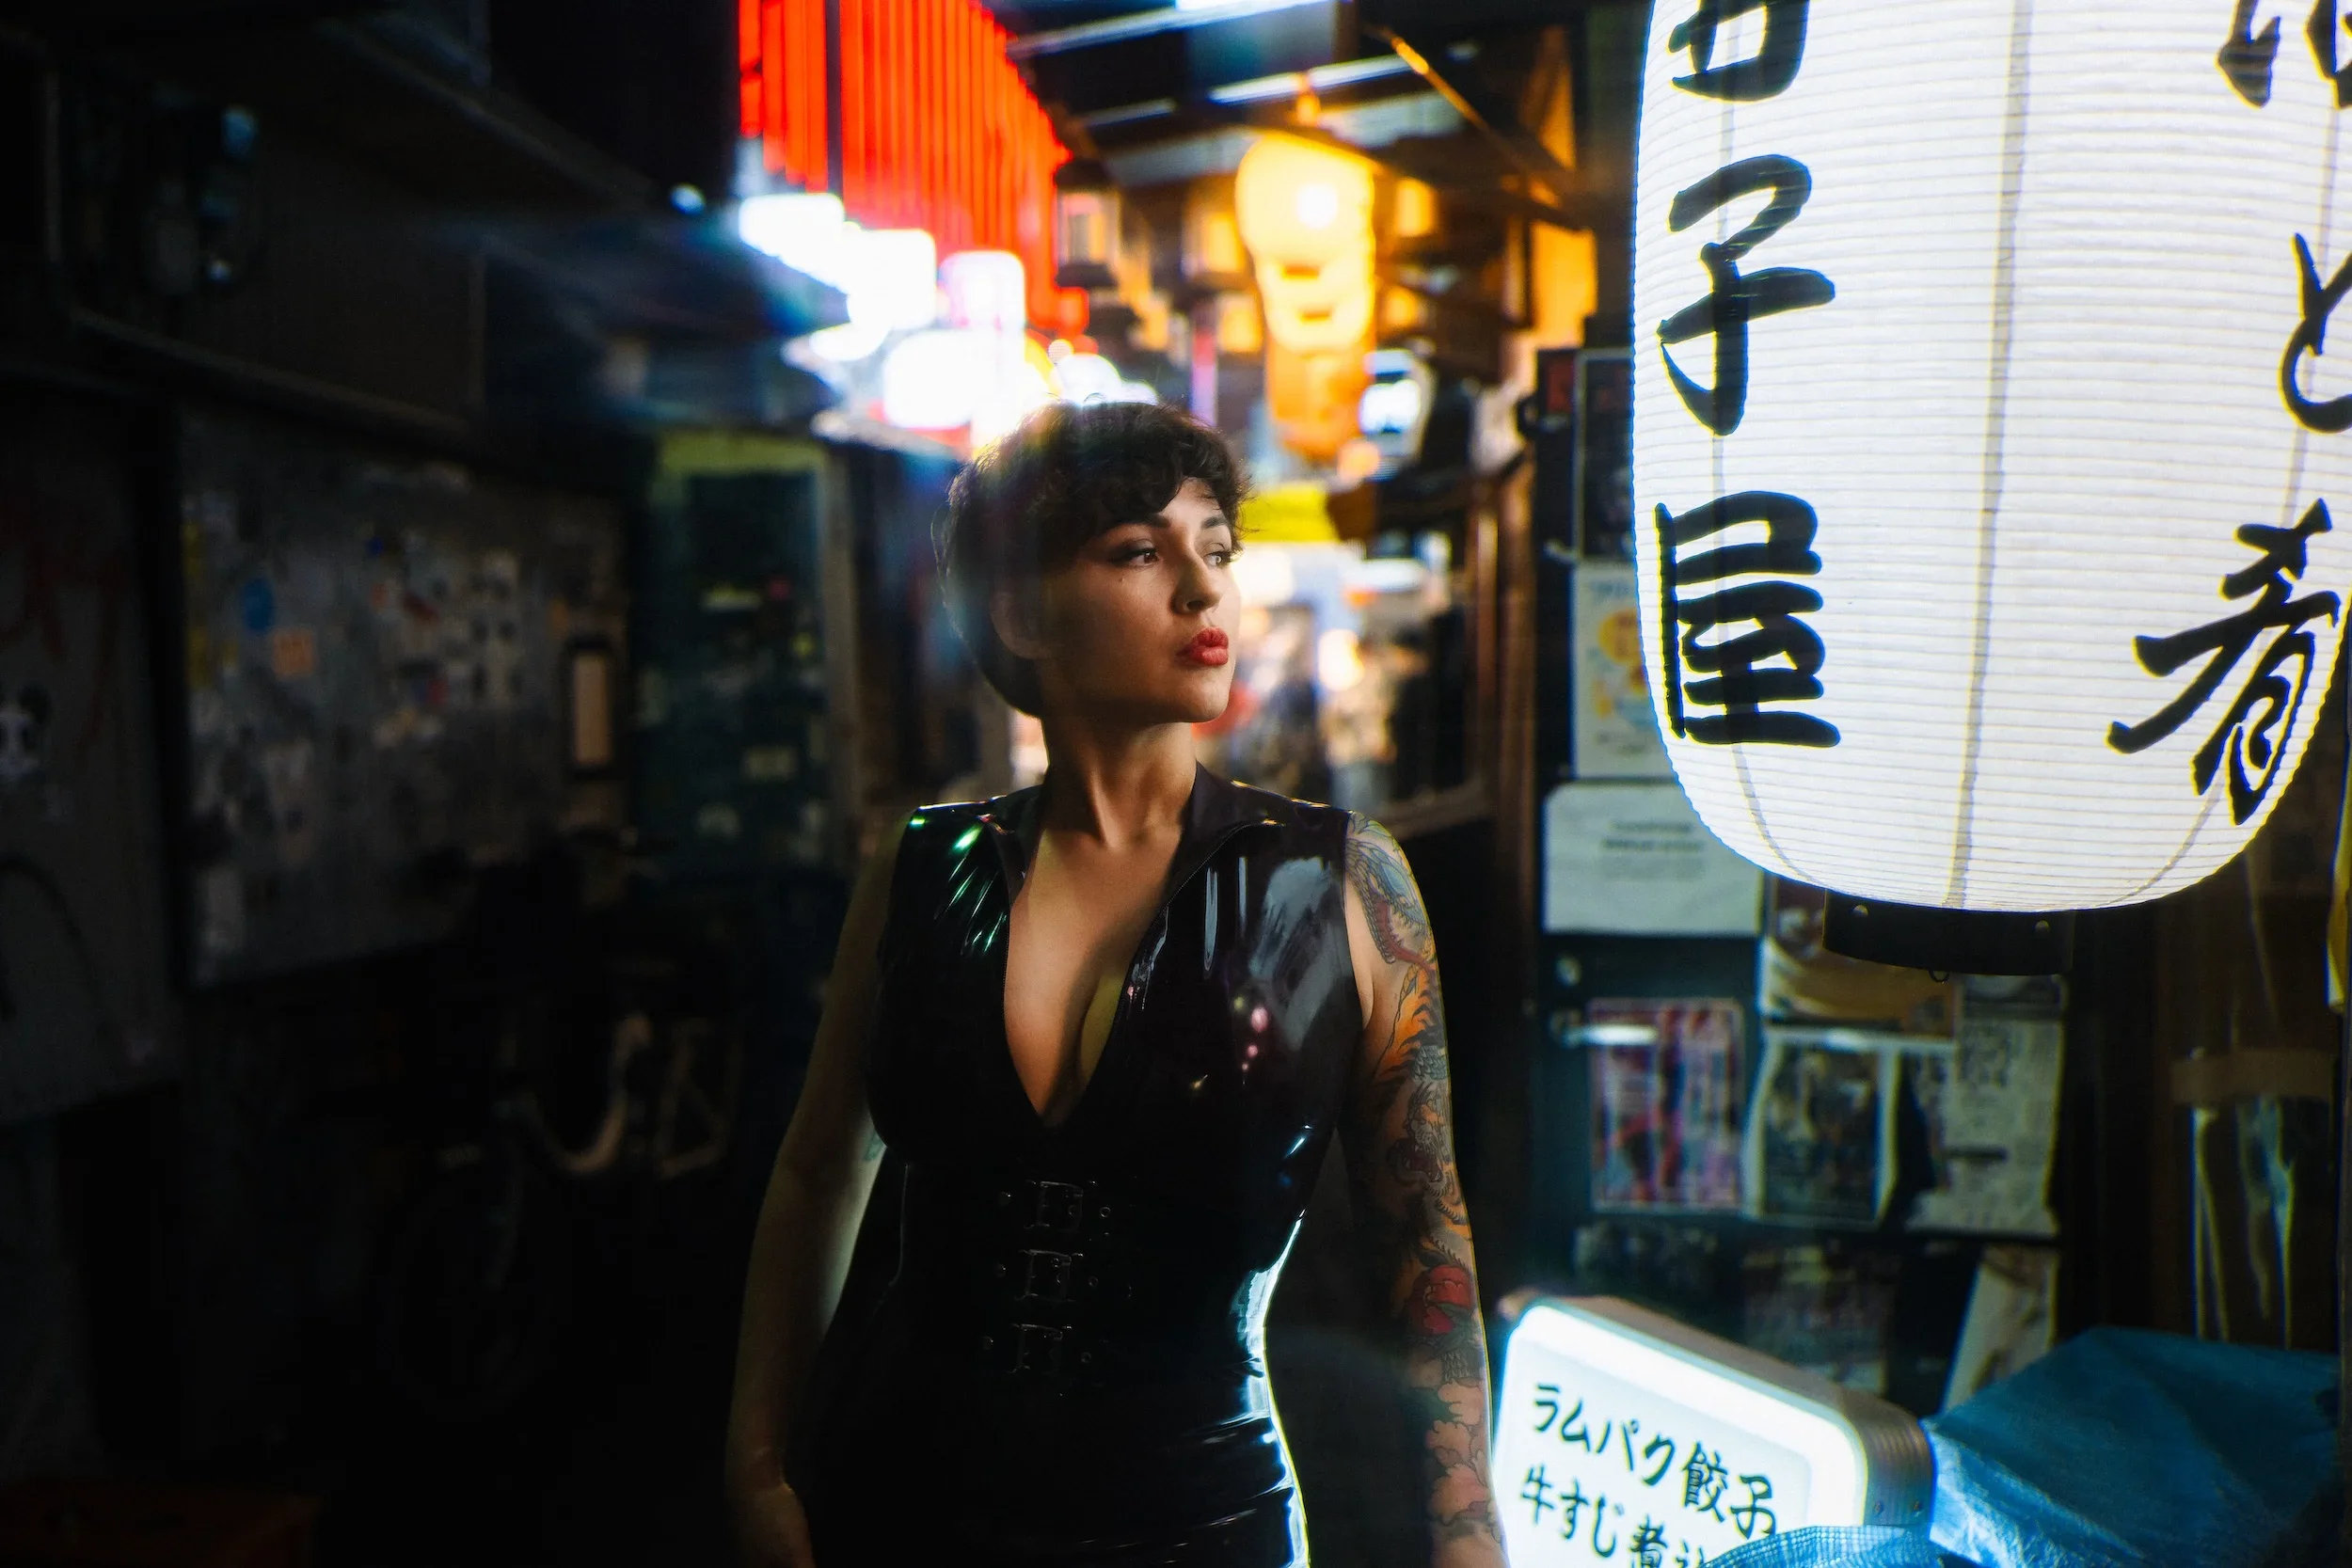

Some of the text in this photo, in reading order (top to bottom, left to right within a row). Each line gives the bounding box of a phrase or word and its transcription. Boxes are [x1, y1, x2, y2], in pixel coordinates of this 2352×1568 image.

[1534, 1383, 1777, 1540] ラムパク餃子
